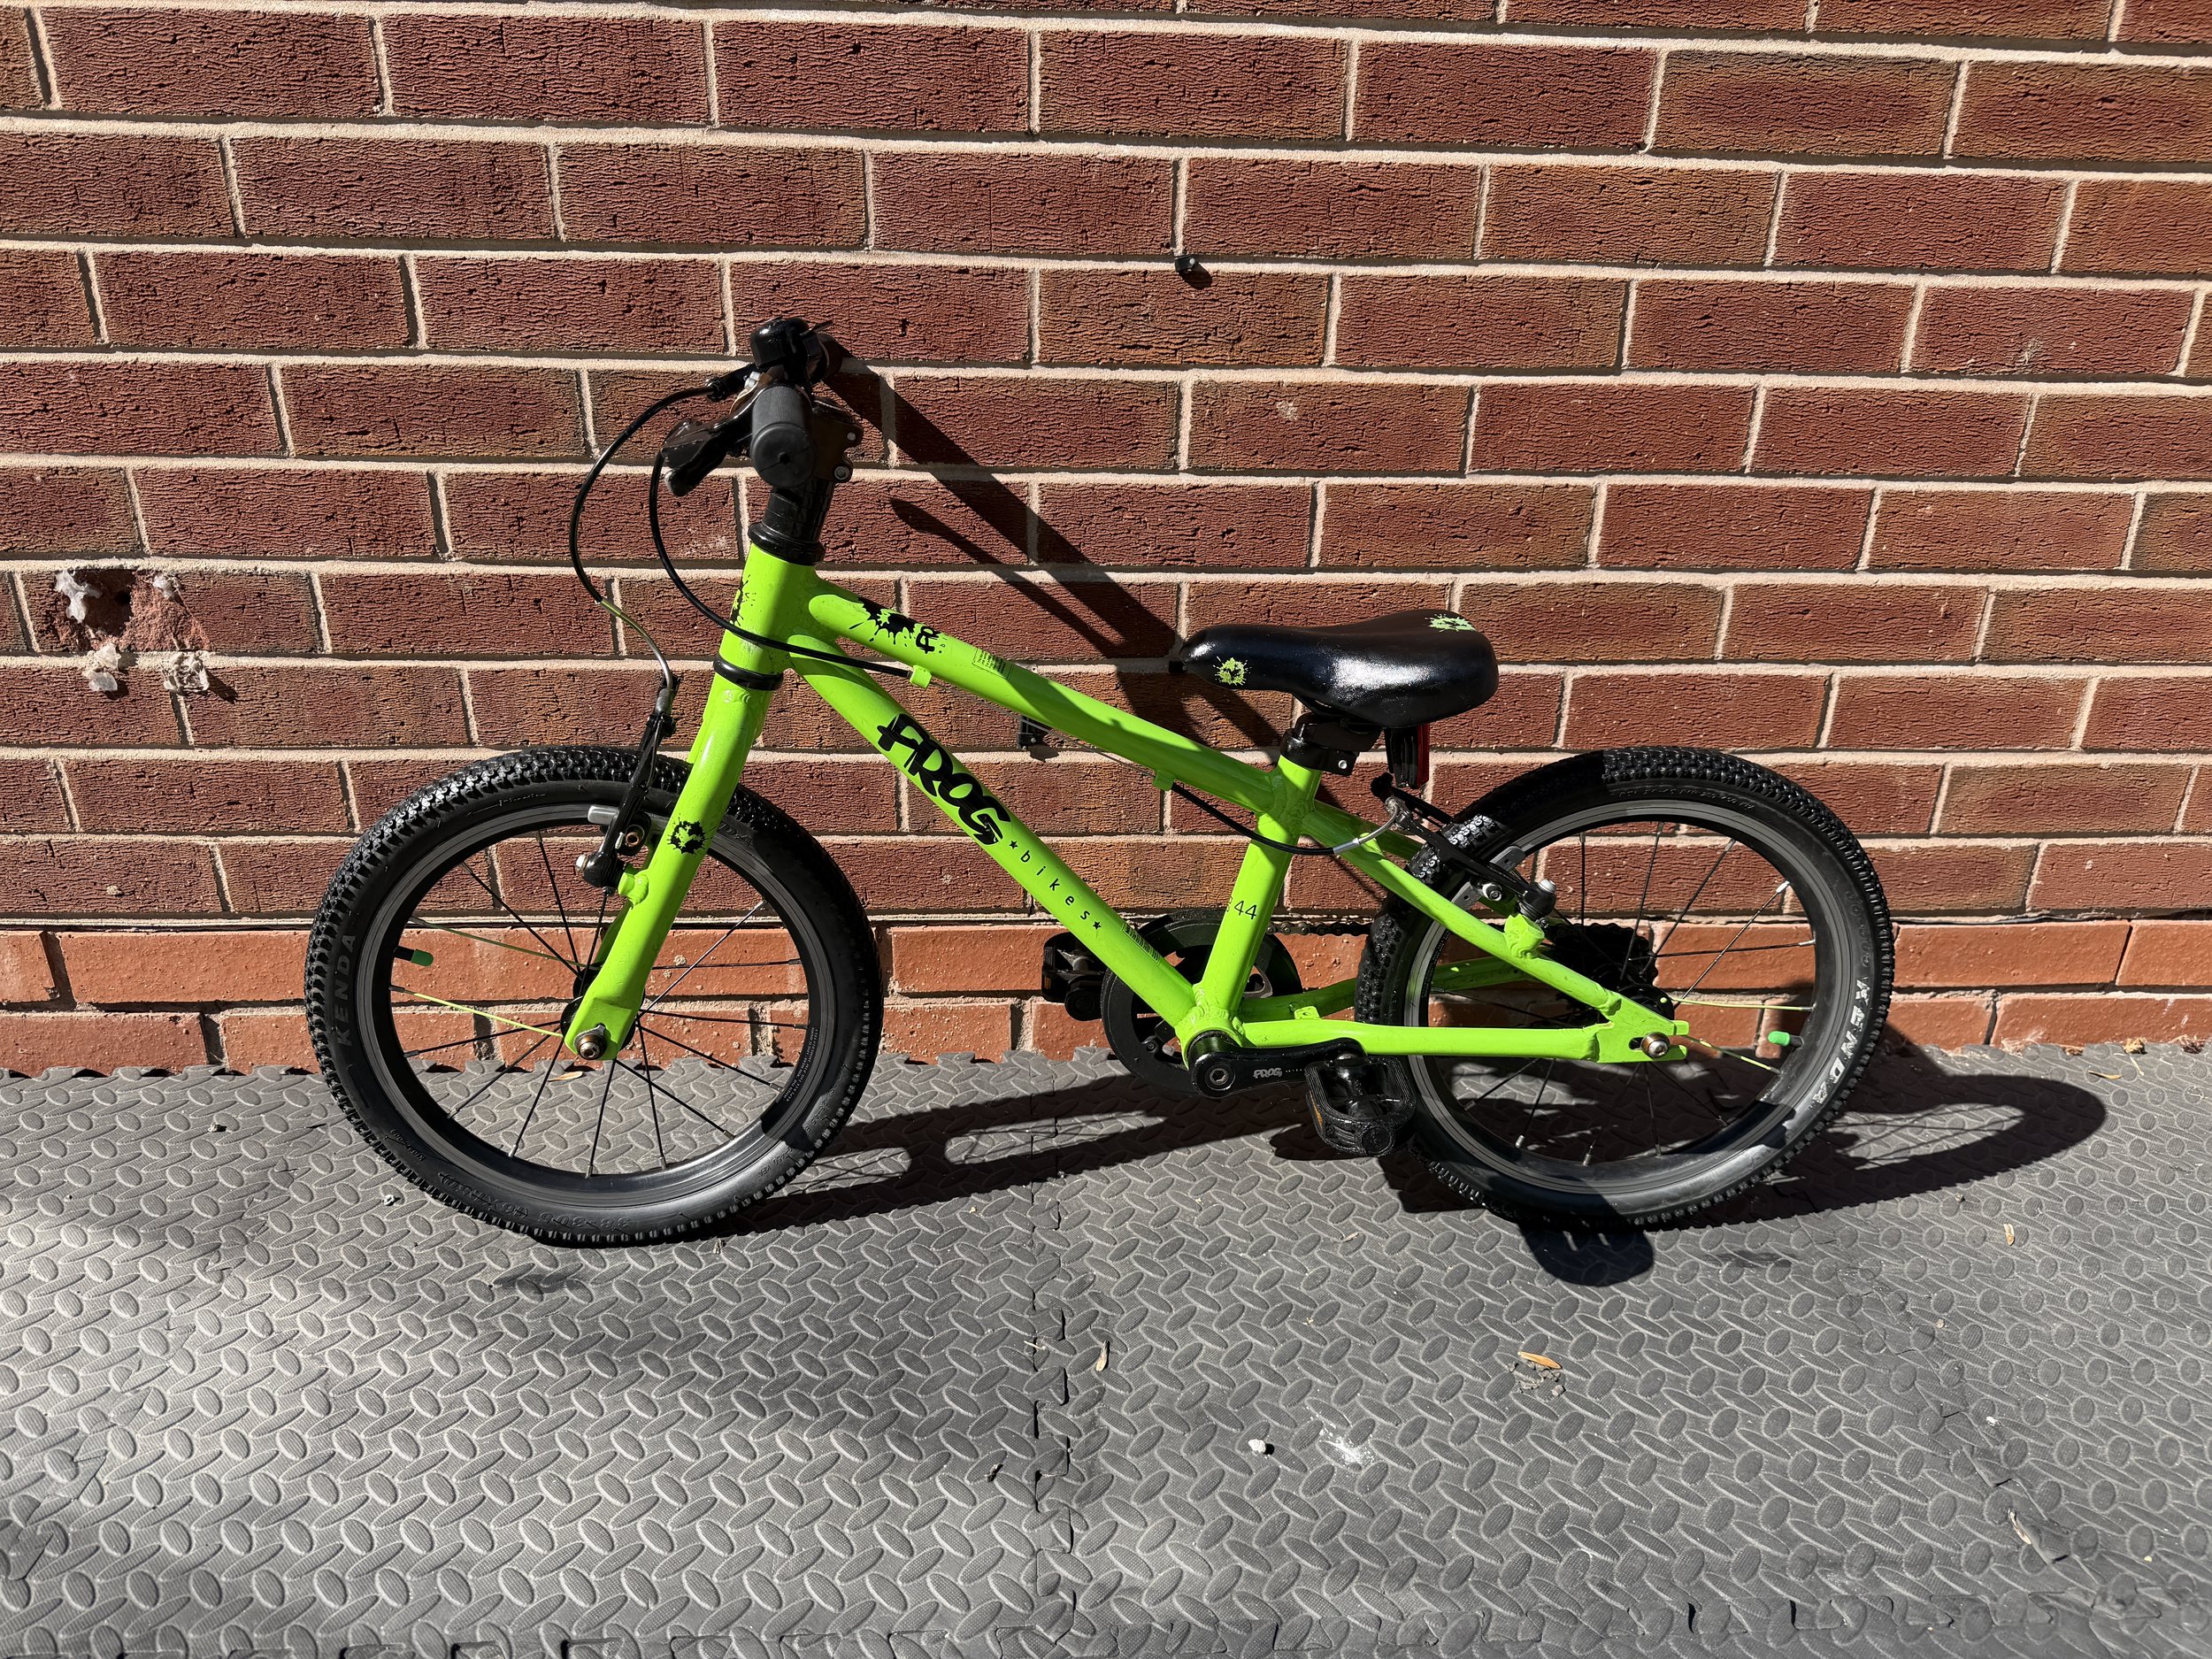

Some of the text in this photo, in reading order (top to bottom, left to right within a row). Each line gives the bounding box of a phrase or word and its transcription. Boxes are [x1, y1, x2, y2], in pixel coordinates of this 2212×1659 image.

[877, 713, 1090, 921] FROG bikes
[1234, 900, 1257, 920] 44
[334, 934, 357, 1047] KENDA
[1814, 976, 1870, 1104] KENDA
[1253, 1067, 1283, 1079] FROG
